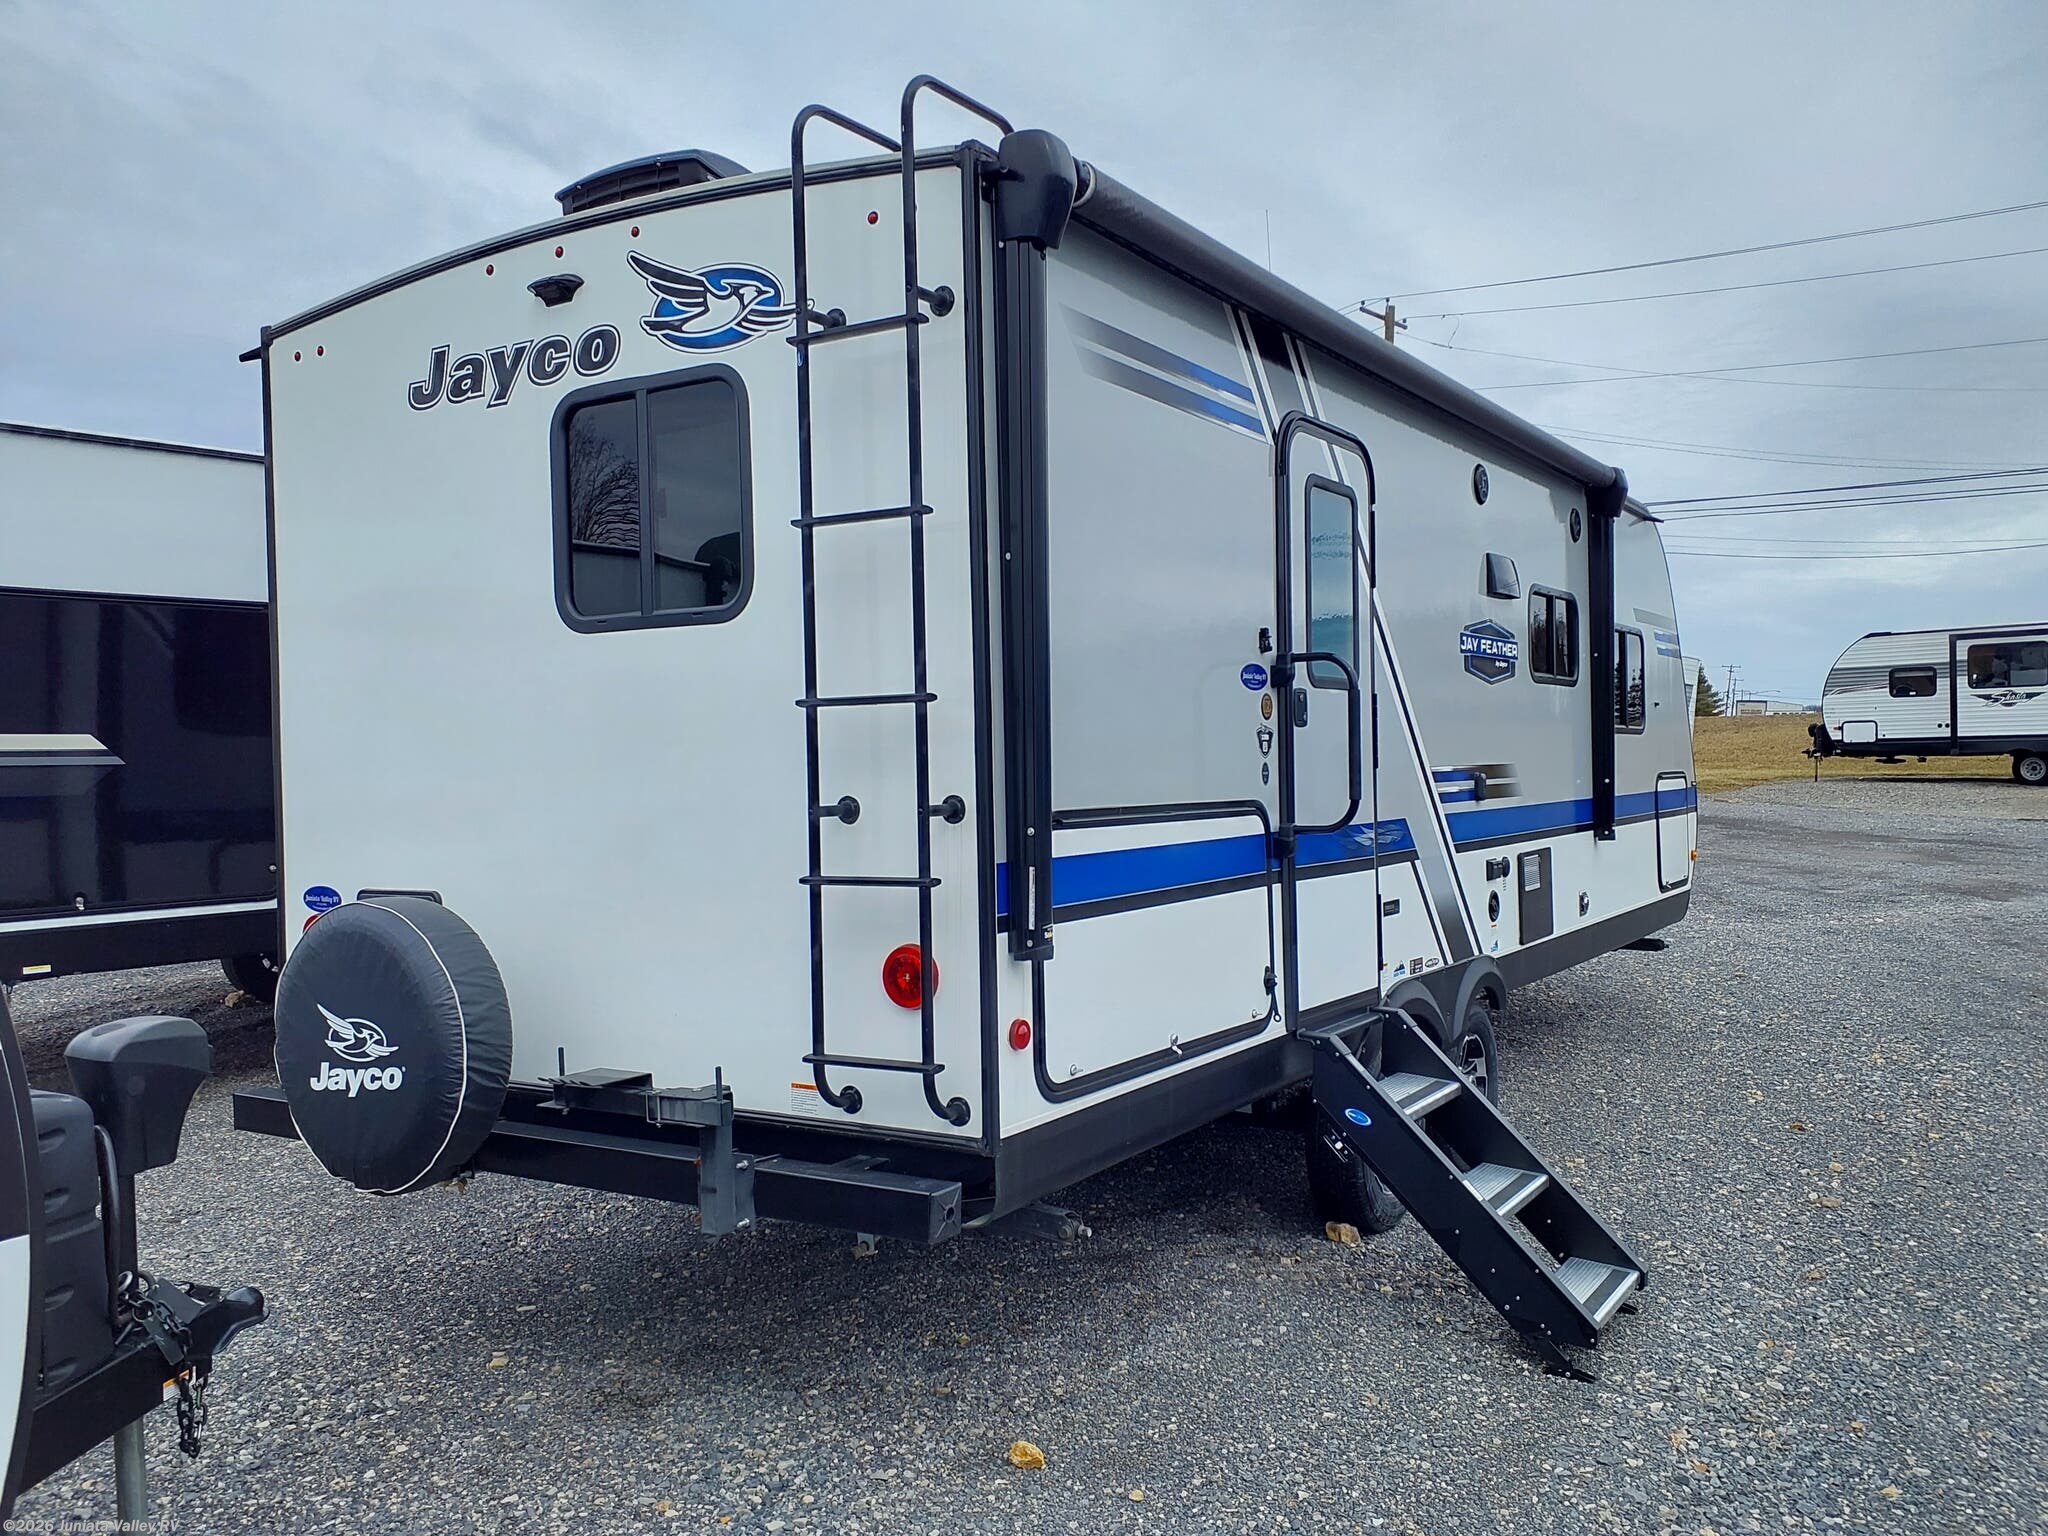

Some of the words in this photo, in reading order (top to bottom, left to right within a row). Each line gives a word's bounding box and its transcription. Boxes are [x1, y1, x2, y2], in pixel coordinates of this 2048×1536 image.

[408, 324, 621, 411] Jayco
[1461, 636, 1478, 651] JAY
[1480, 640, 1518, 657] FEATHER
[310, 1062, 403, 1097] Jayco
